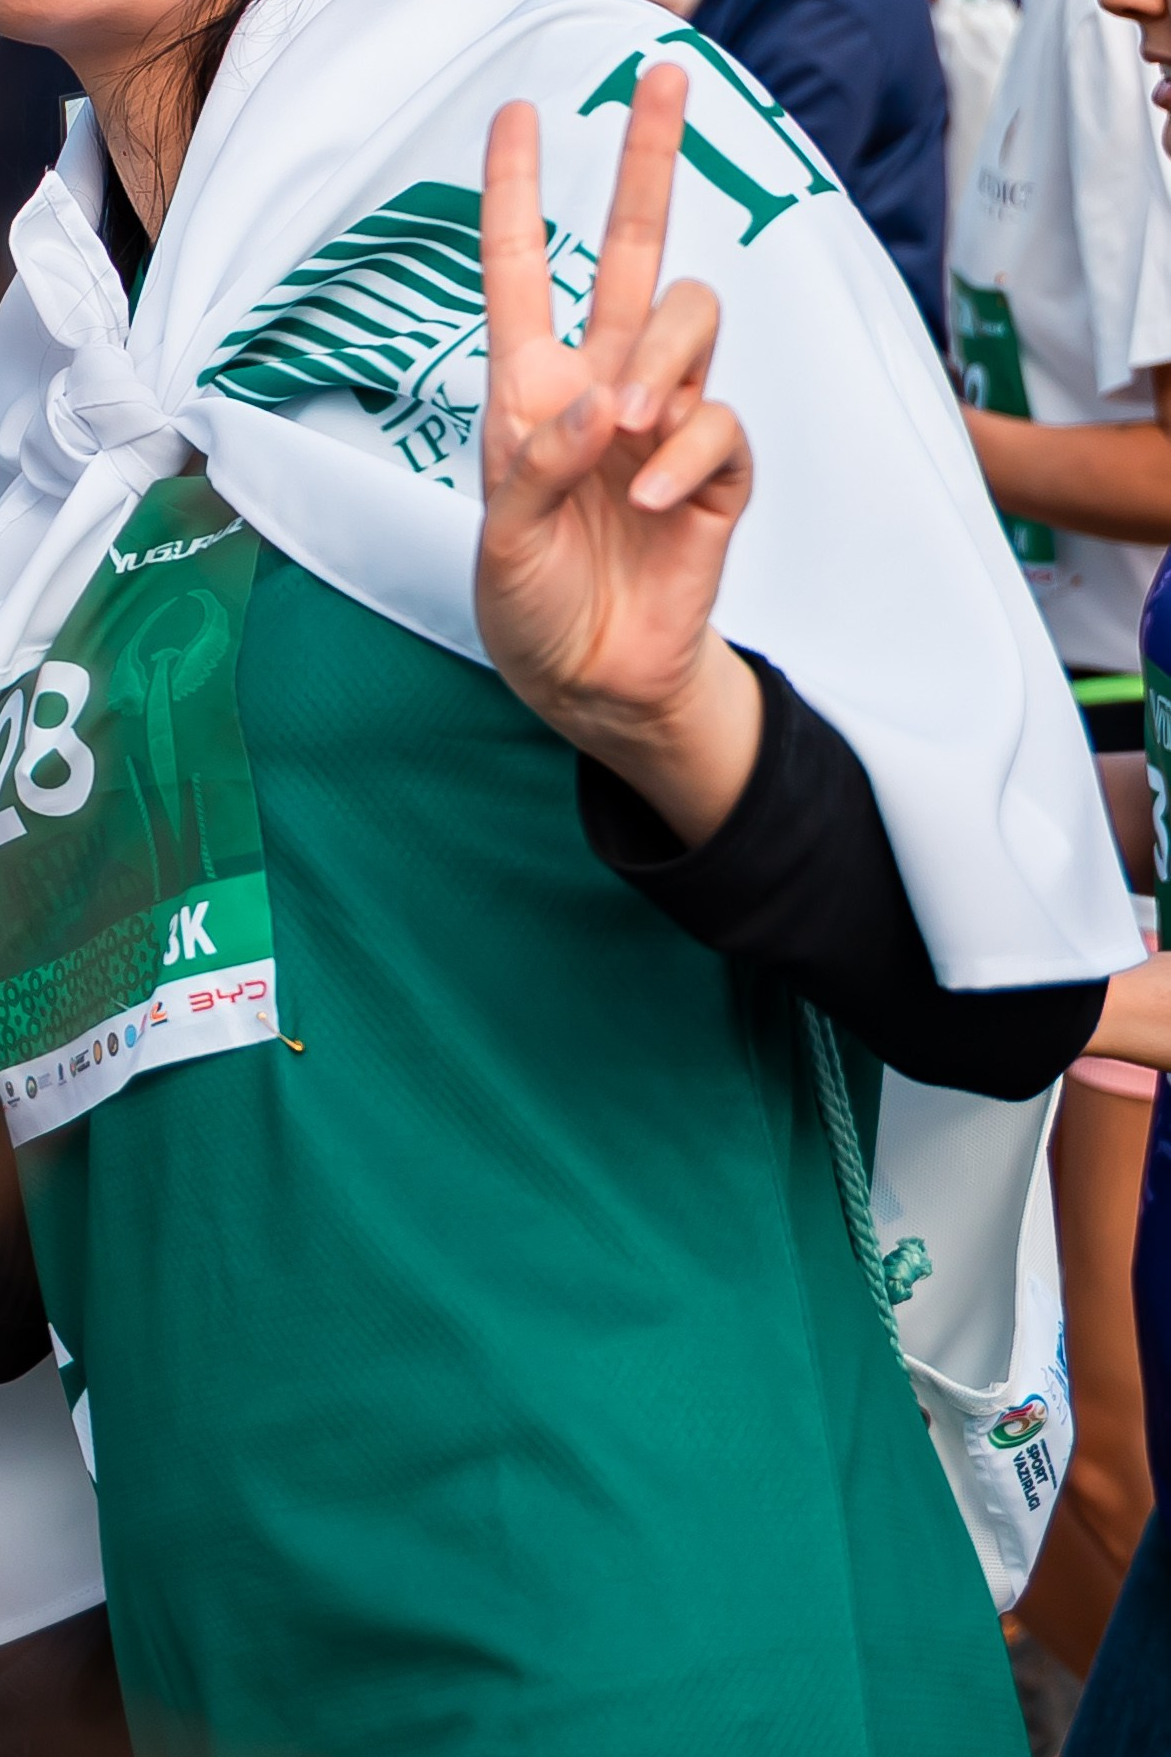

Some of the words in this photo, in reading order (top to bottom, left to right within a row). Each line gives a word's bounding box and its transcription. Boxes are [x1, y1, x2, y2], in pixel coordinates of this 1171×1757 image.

[189, 980, 267, 1012] BYD
[1013, 1450, 1040, 1511] VAZIRLIGI
[1026, 1443, 1048, 1484] SPORT
